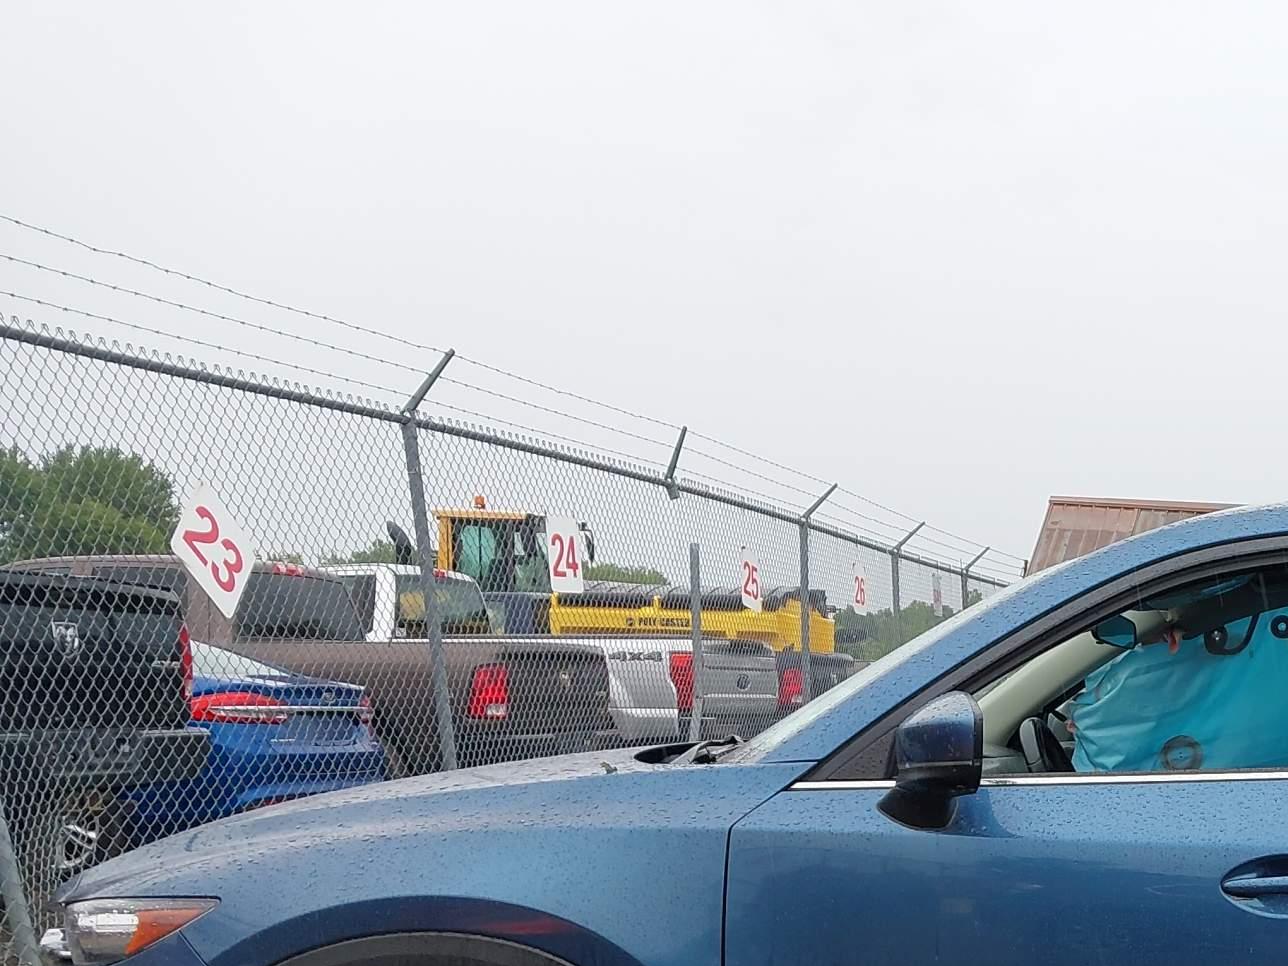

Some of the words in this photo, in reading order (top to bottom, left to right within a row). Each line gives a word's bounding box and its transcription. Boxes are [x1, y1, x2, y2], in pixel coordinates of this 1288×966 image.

[182, 505, 244, 593] 23
[551, 533, 579, 579] 24
[743, 560, 759, 601] 25
[854, 575, 866, 606] 26
